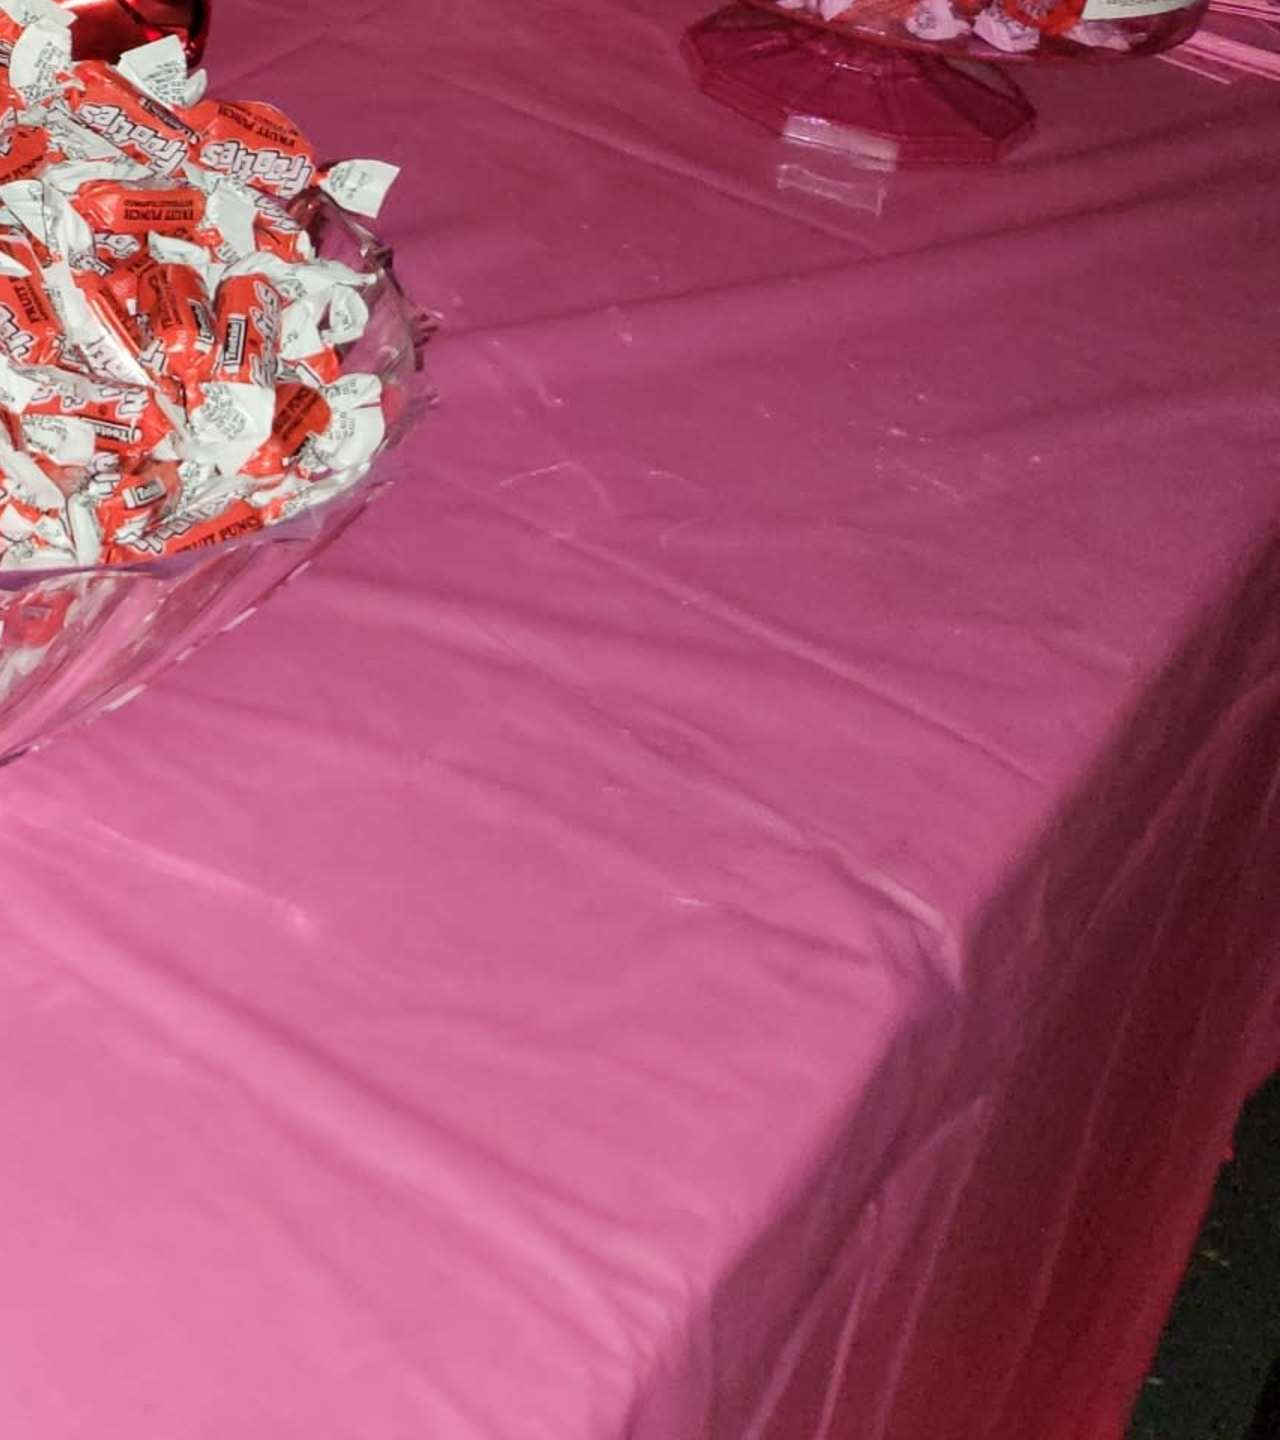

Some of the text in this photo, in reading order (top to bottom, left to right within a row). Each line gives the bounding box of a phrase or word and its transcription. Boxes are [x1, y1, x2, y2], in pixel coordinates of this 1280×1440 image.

[78, 105, 188, 176] Frooties
[256, 125, 297, 148] FRUIT
[199, 140, 313, 199] Frooties
[220, 321, 245, 358] Tootsie
[94, 425, 129, 441] Toots
[217, 515, 261, 540] PUNC
